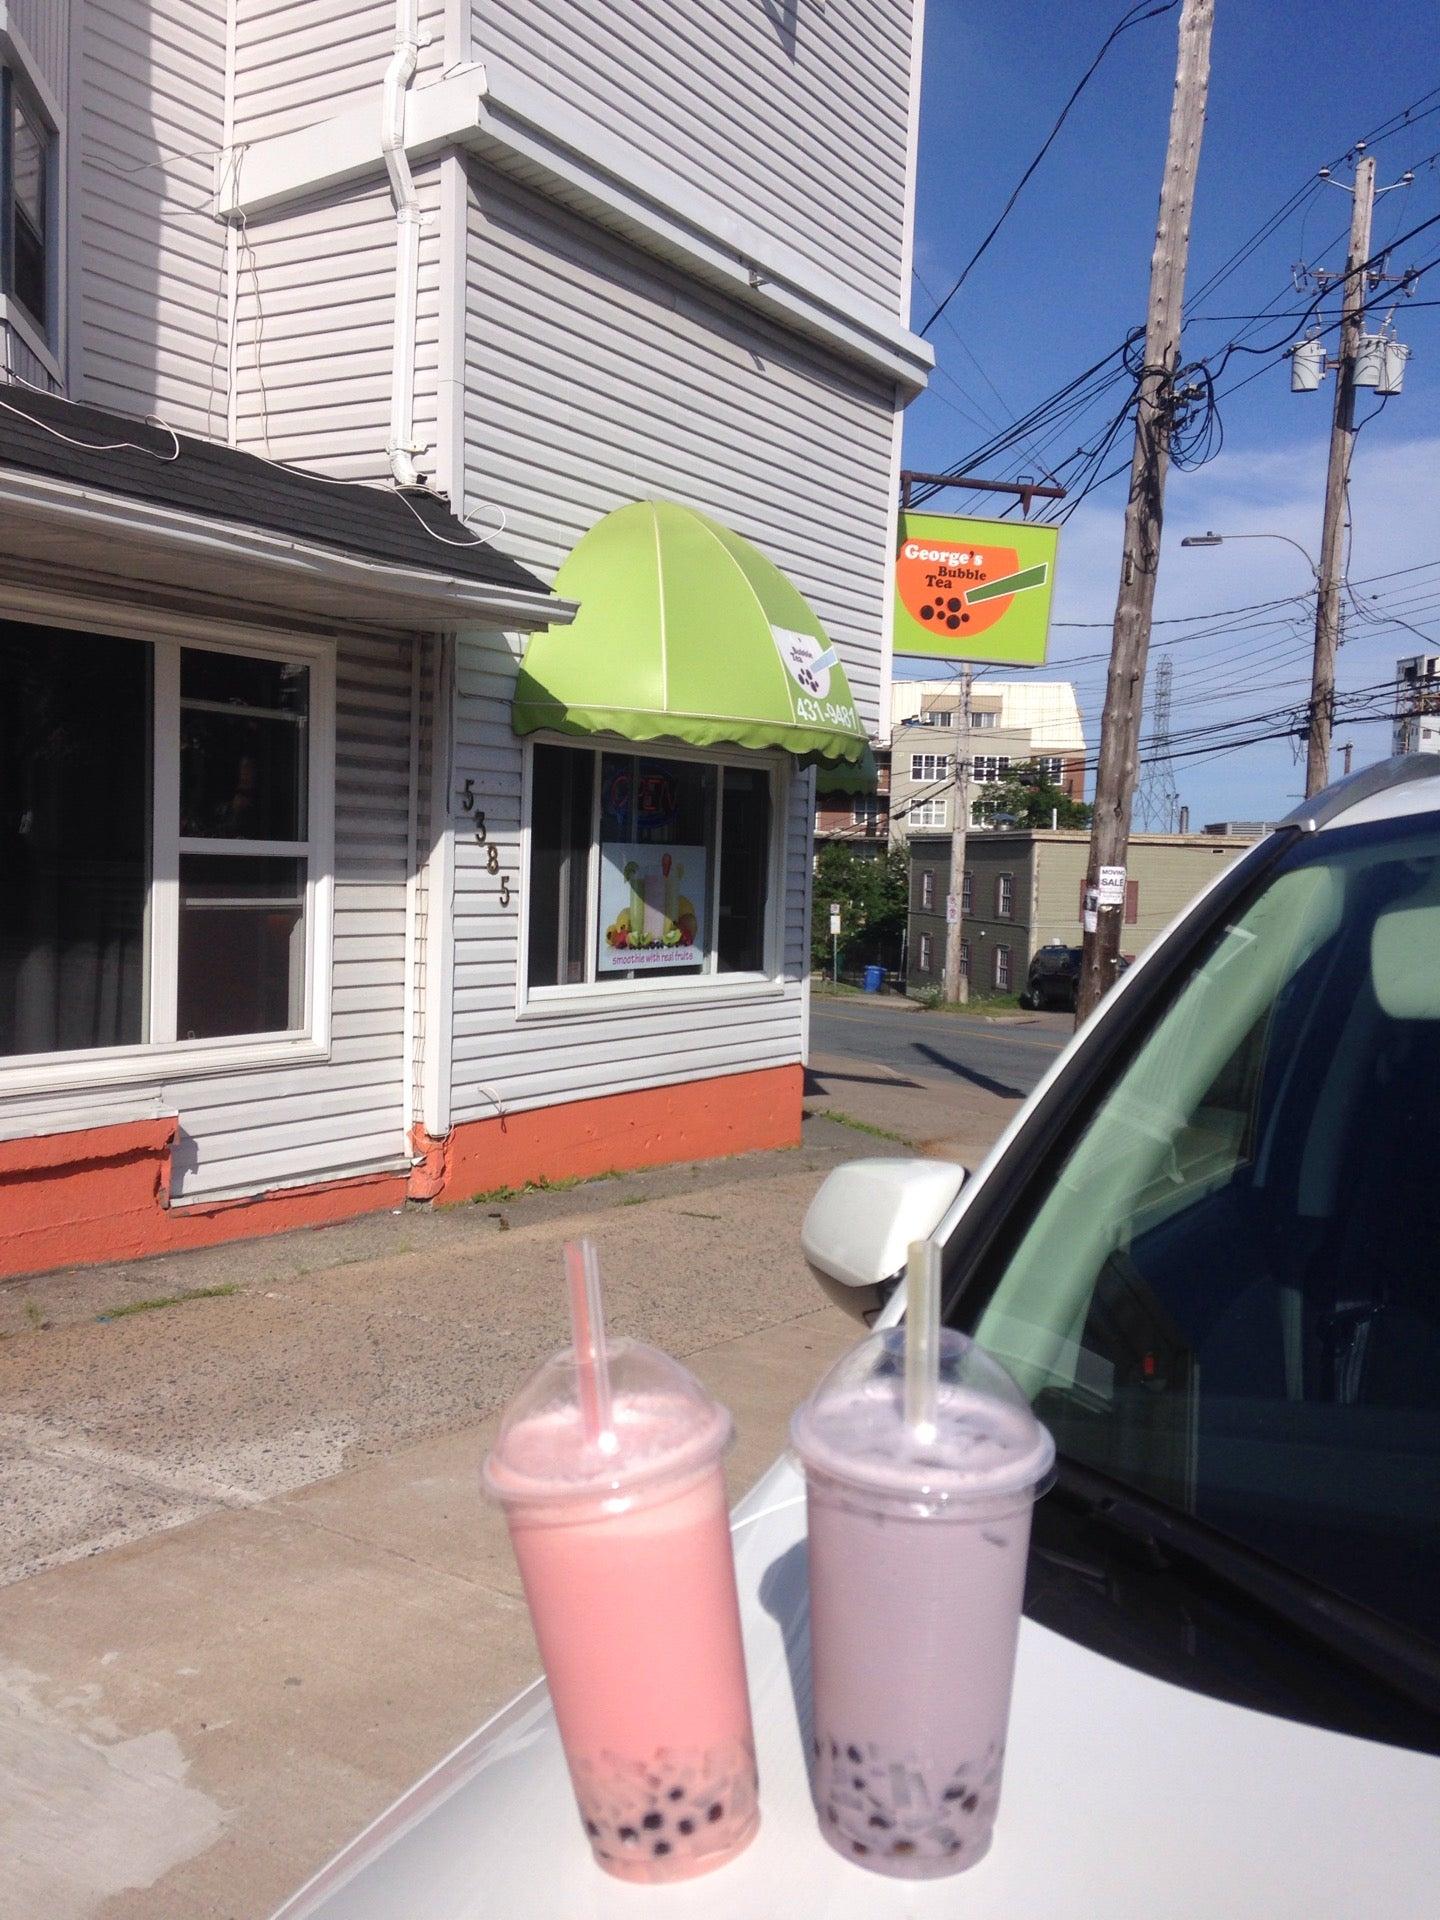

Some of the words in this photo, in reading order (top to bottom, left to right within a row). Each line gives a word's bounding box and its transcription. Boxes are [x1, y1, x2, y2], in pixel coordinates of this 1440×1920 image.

[904, 544, 984, 566] George's
[925, 574, 953, 588] Tea
[938, 566, 987, 581] Bubble
[797, 698, 857, 730] 431-9481
[1102, 878, 1124, 887] SALE
[612, 954, 645, 966] smoothie
[646, 953, 661, 963] with
[661, 952, 673, 962] real
[674, 951, 693, 961] fruits
